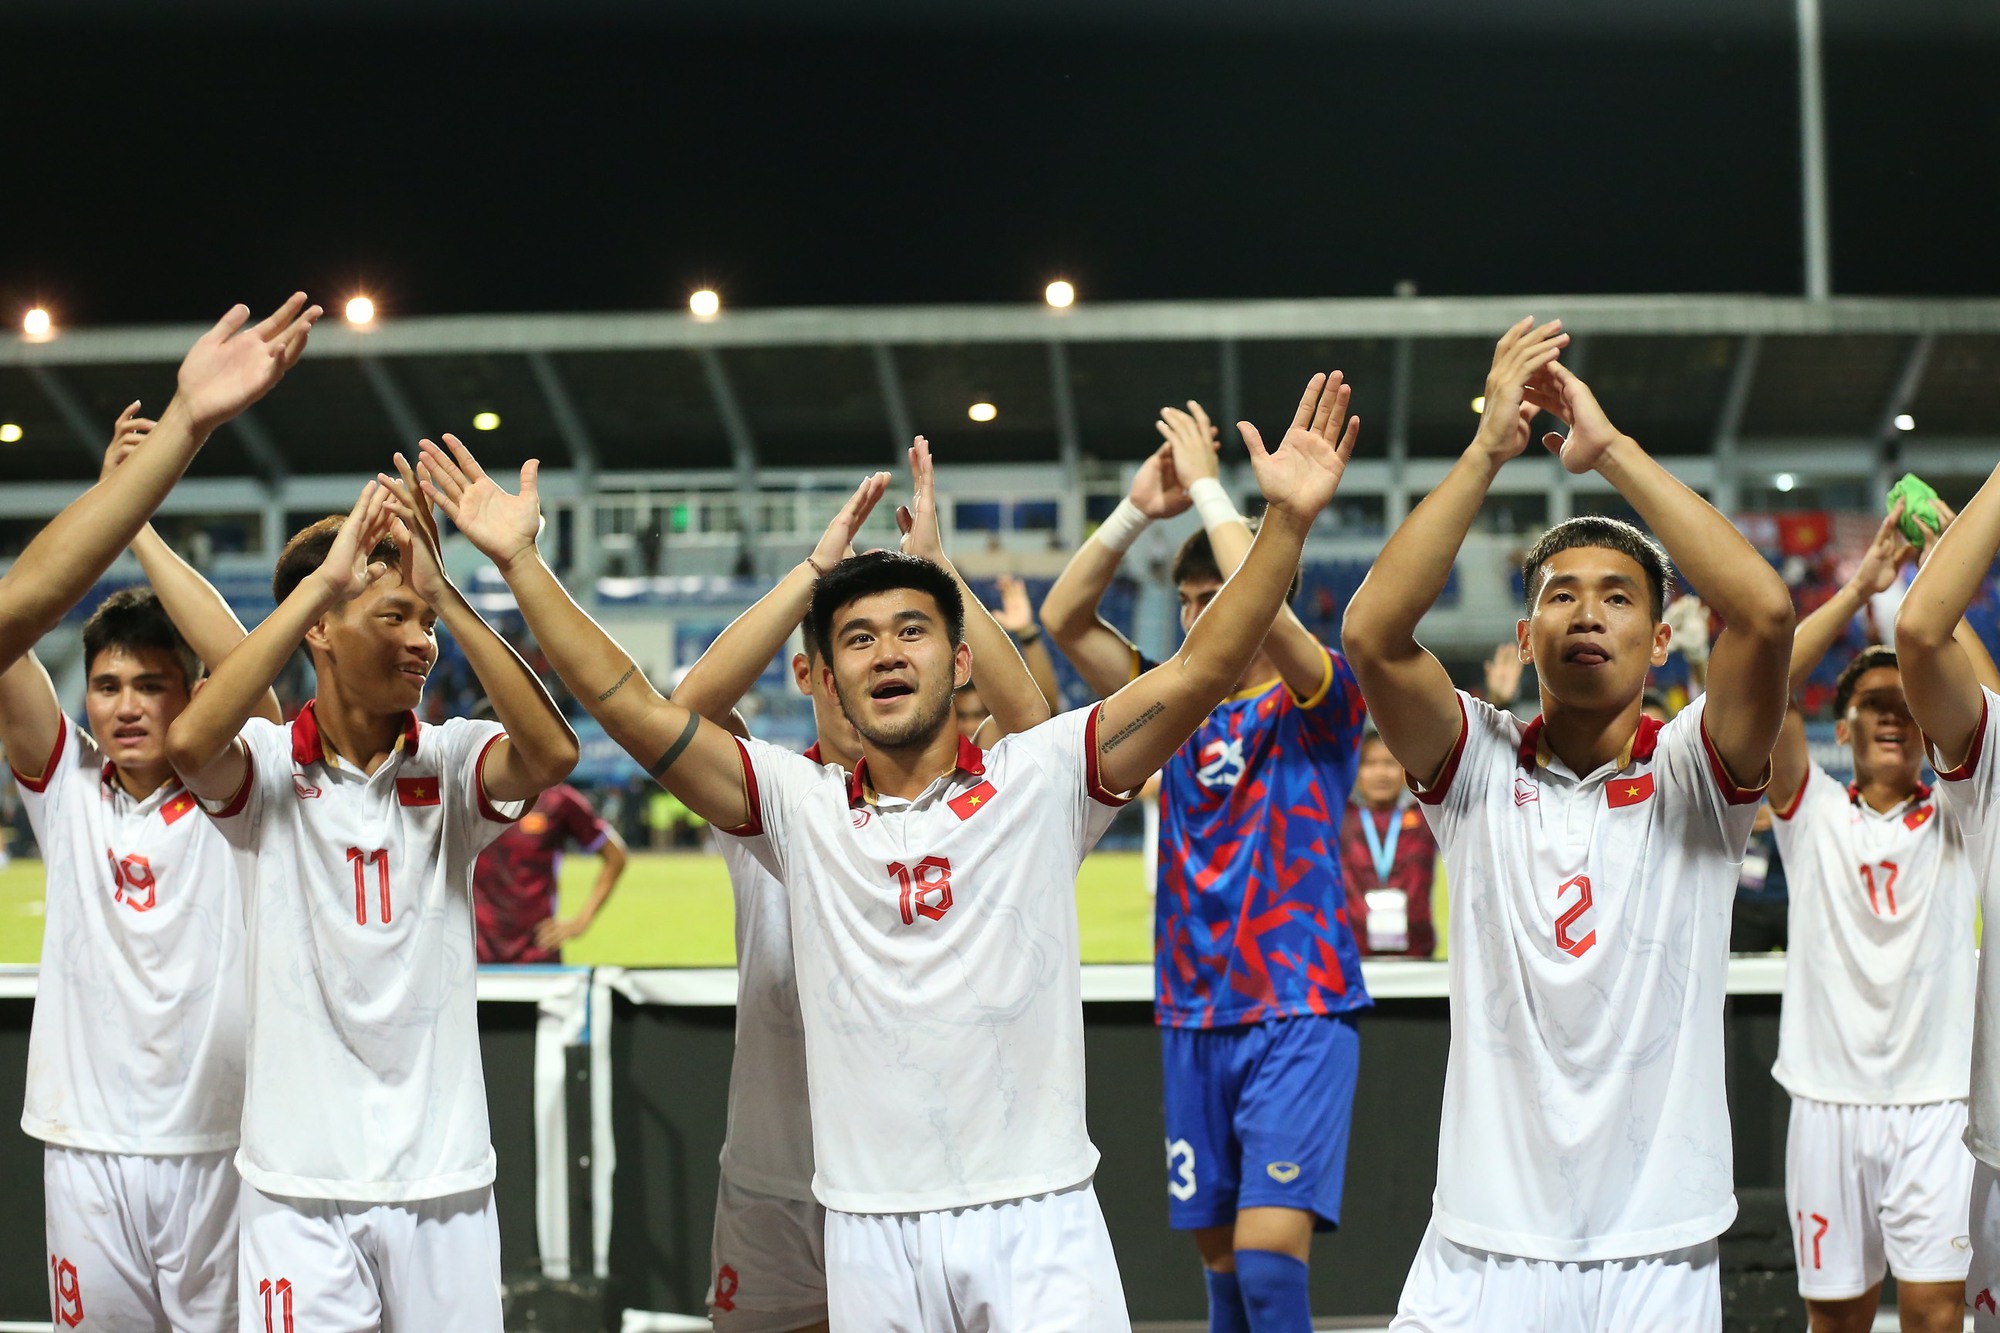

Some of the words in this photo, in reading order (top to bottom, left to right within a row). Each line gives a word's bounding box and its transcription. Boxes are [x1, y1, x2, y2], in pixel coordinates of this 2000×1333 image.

[1108, 723, 1144, 750] STRENGTHEN
[1154, 705, 1166, 715] USE
[1124, 721, 1137, 732] LIKE
[1140, 701, 1162, 719] MUSCLE
[107, 847, 156, 913] 19
[345, 846, 392, 927] 11
[886, 855, 953, 927] 18
[1859, 860, 1899, 916] 17
[1554, 874, 1597, 959] 2
[1797, 1210, 1829, 1270] 17
[51, 1254, 85, 1329] 19
[259, 1277, 295, 1333] 11
